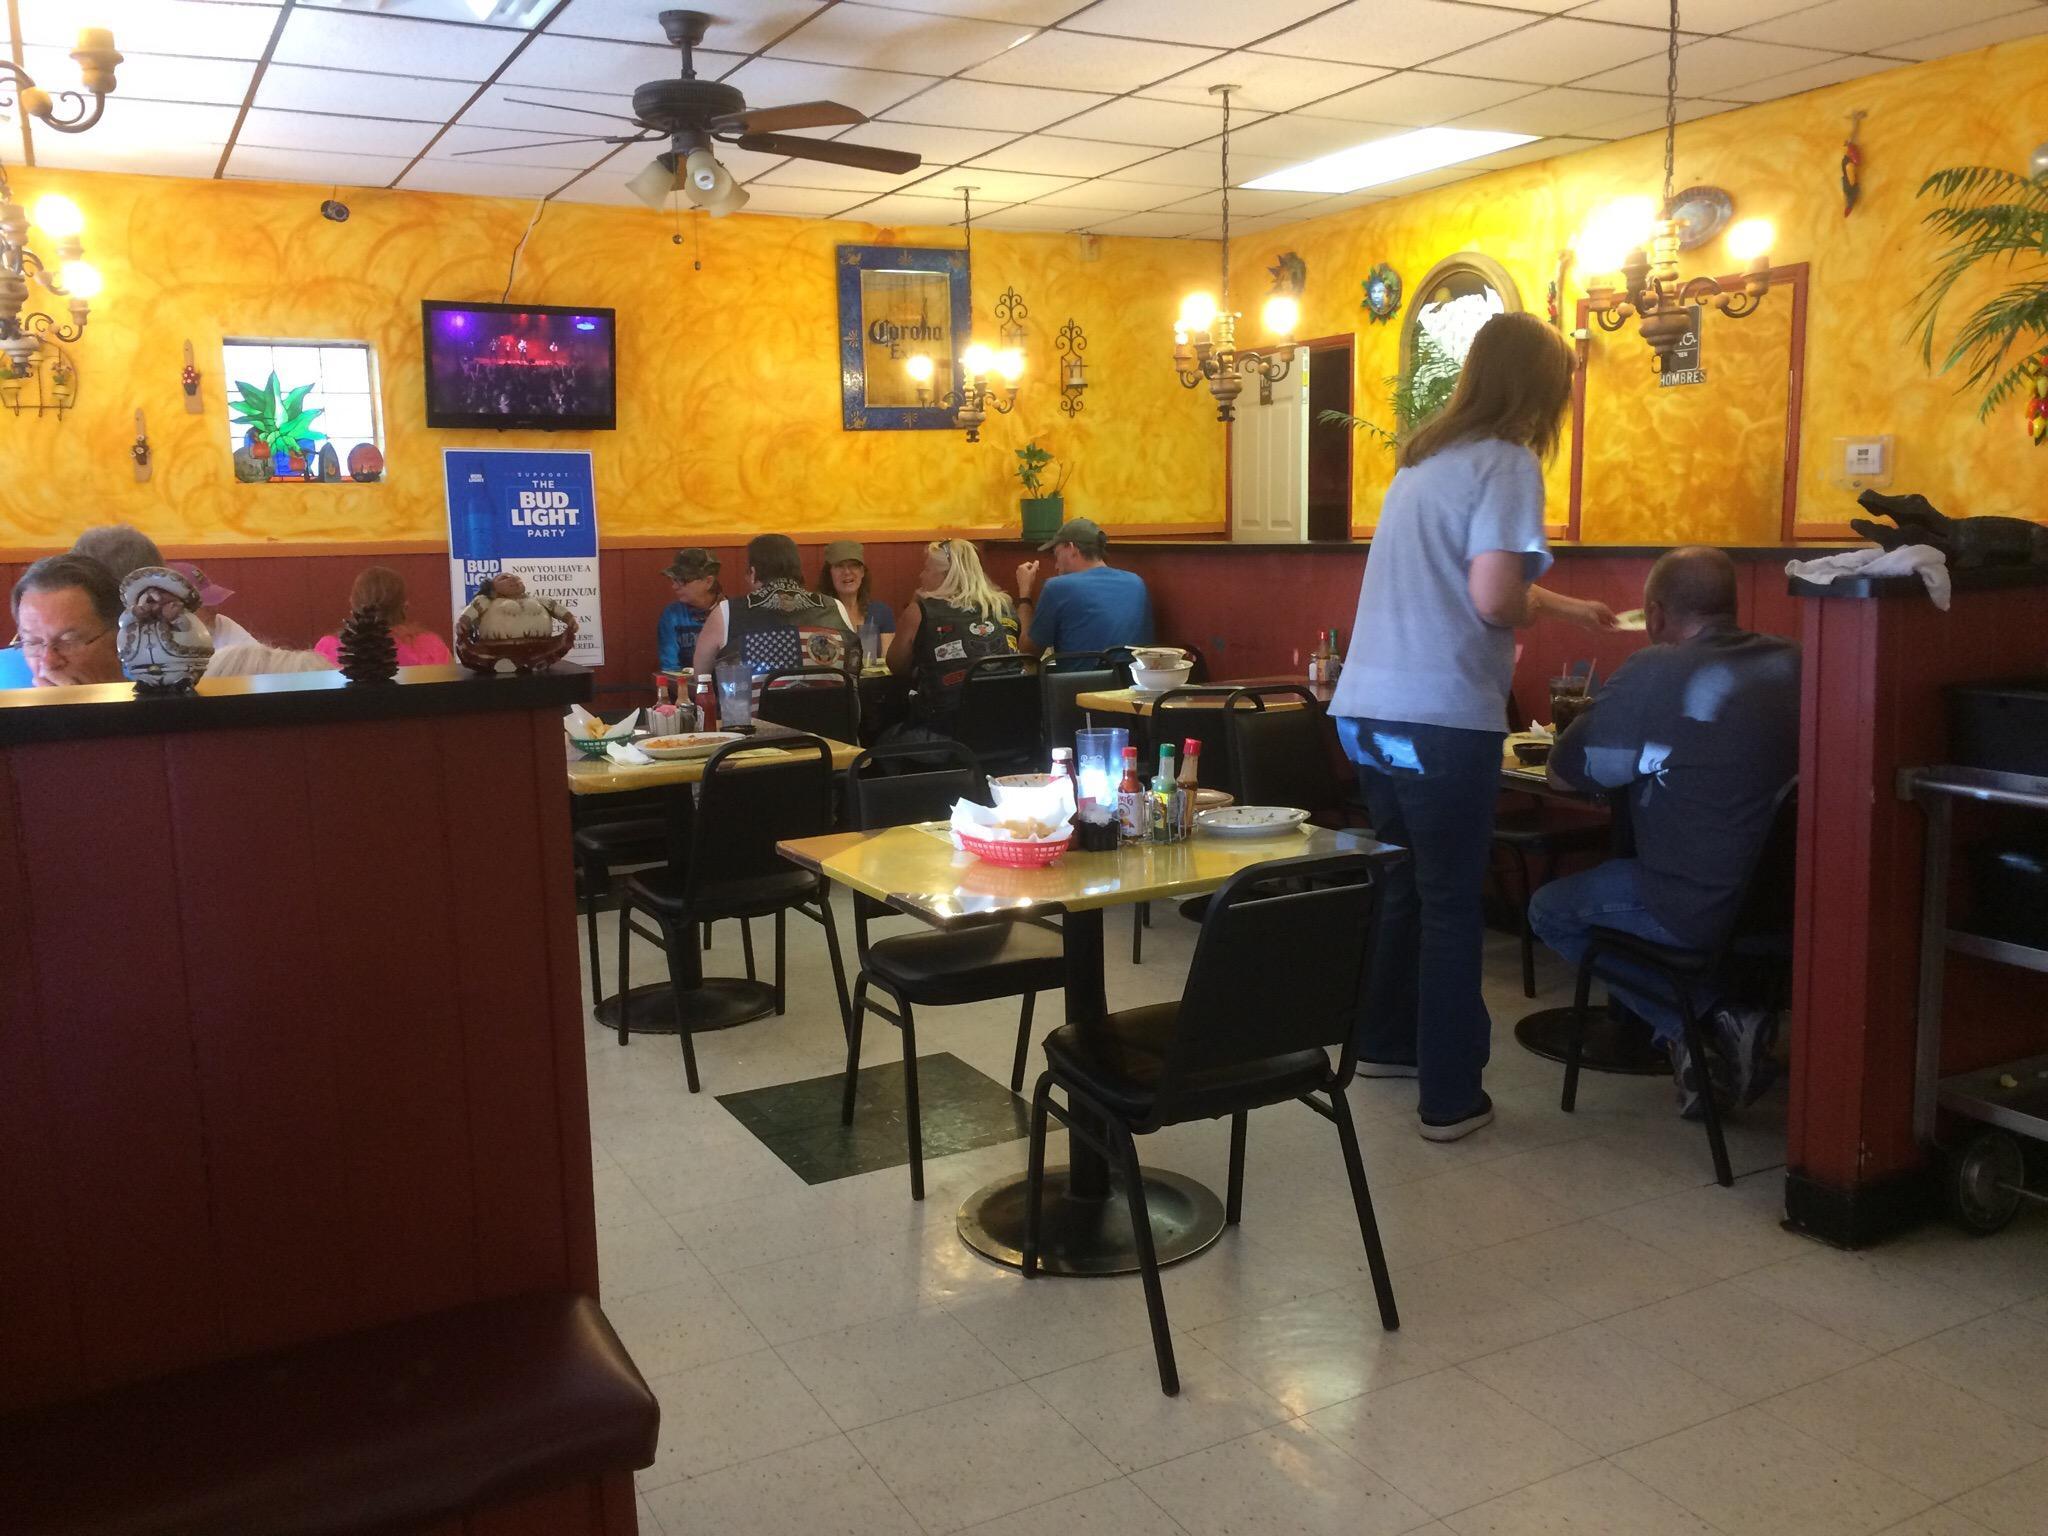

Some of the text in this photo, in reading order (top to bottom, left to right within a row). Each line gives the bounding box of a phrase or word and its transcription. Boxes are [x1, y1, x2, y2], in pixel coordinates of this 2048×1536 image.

[868, 319, 943, 347] Corona
[1660, 371, 1705, 386] HOMBRES
[531, 480, 555, 489] THE
[519, 491, 570, 509] BUD
[511, 508, 580, 526] LIGHT
[527, 529, 566, 538] PARTY
[467, 559, 500, 573] BUD
[512, 564, 592, 573] NOW YOU HAVE A
[532, 573, 573, 582] CHOICE!
[533, 587, 597, 597] ALUMINUM
